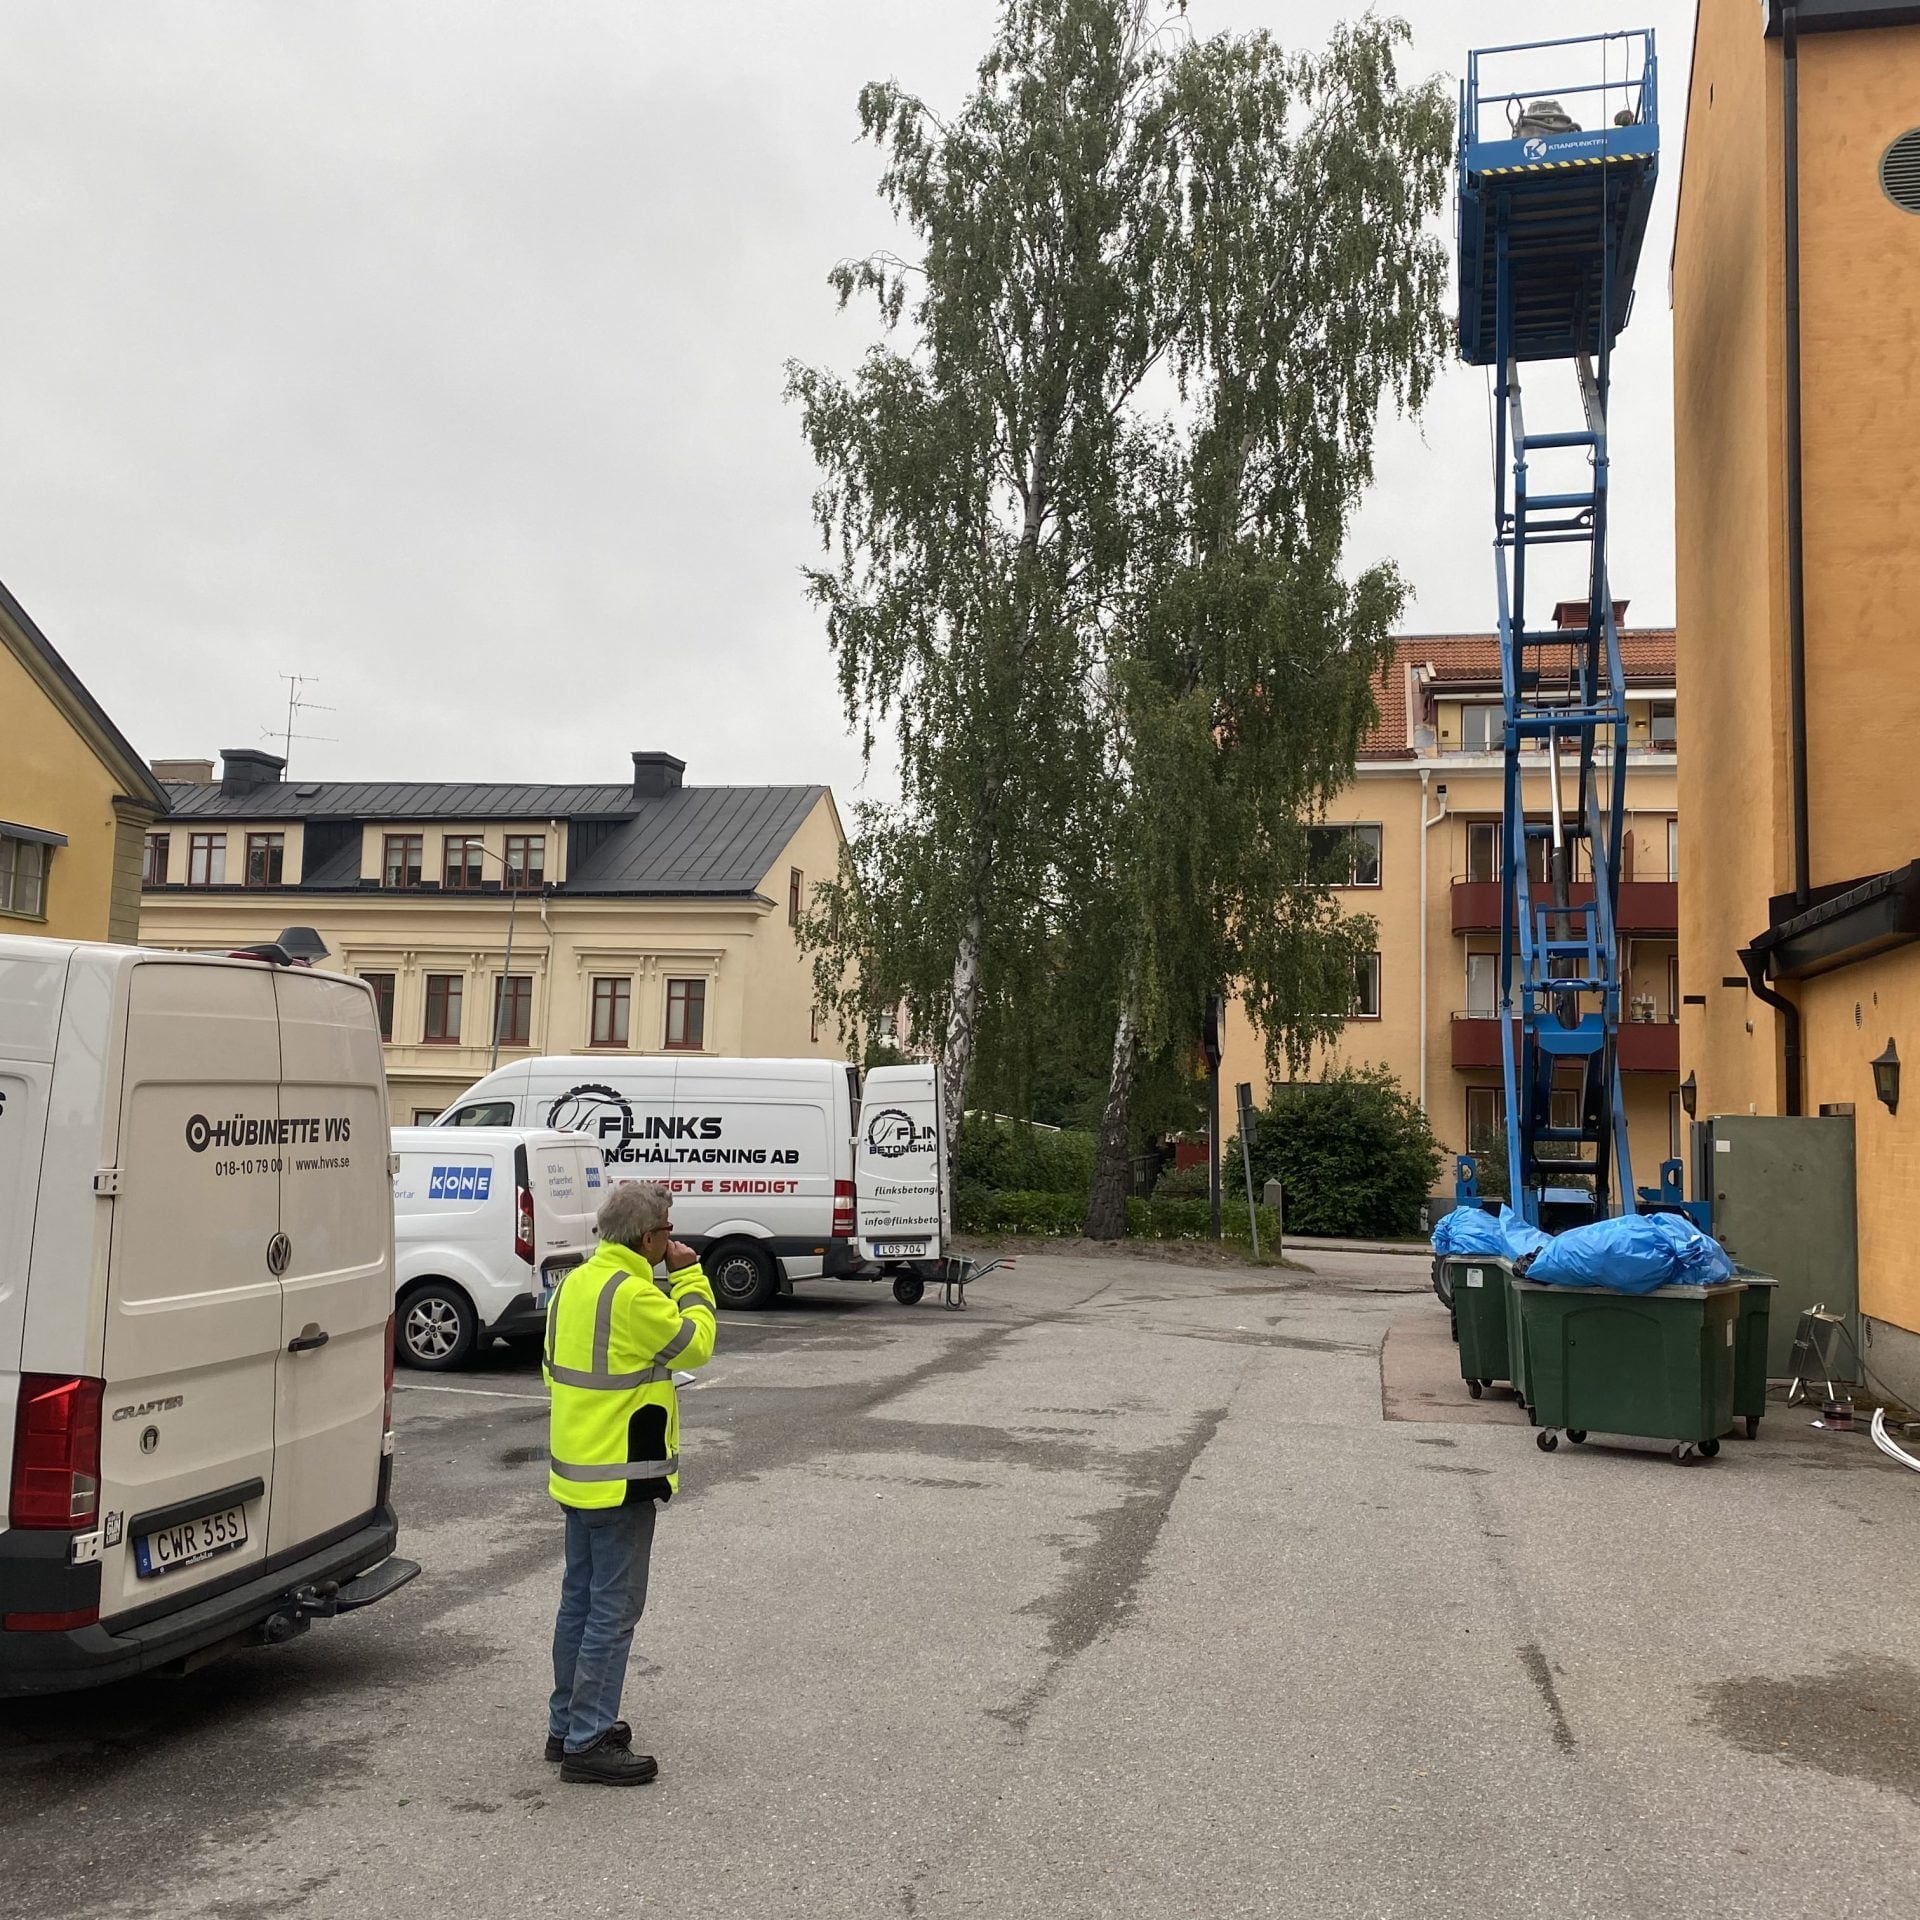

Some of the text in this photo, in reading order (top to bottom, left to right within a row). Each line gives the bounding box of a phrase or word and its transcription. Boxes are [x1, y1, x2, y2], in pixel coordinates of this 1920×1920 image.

[215, 1113, 351, 1147] HÜBINETTE VVS
[598, 1116, 723, 1140] FLINKS
[295, 1155, 350, 1172] www.hvvs.se
[600, 1143, 800, 1164] NGHÅLTAGNING AB
[215, 1157, 284, 1177] 018-10 79 00
[431, 1175, 490, 1191] KONE
[719, 1180, 800, 1194] SMIDIGT
[882, 1244, 921, 1255] LOS 704
[112, 1395, 184, 1422] CRAFTER
[157, 1511, 238, 1562] CWR 35S
